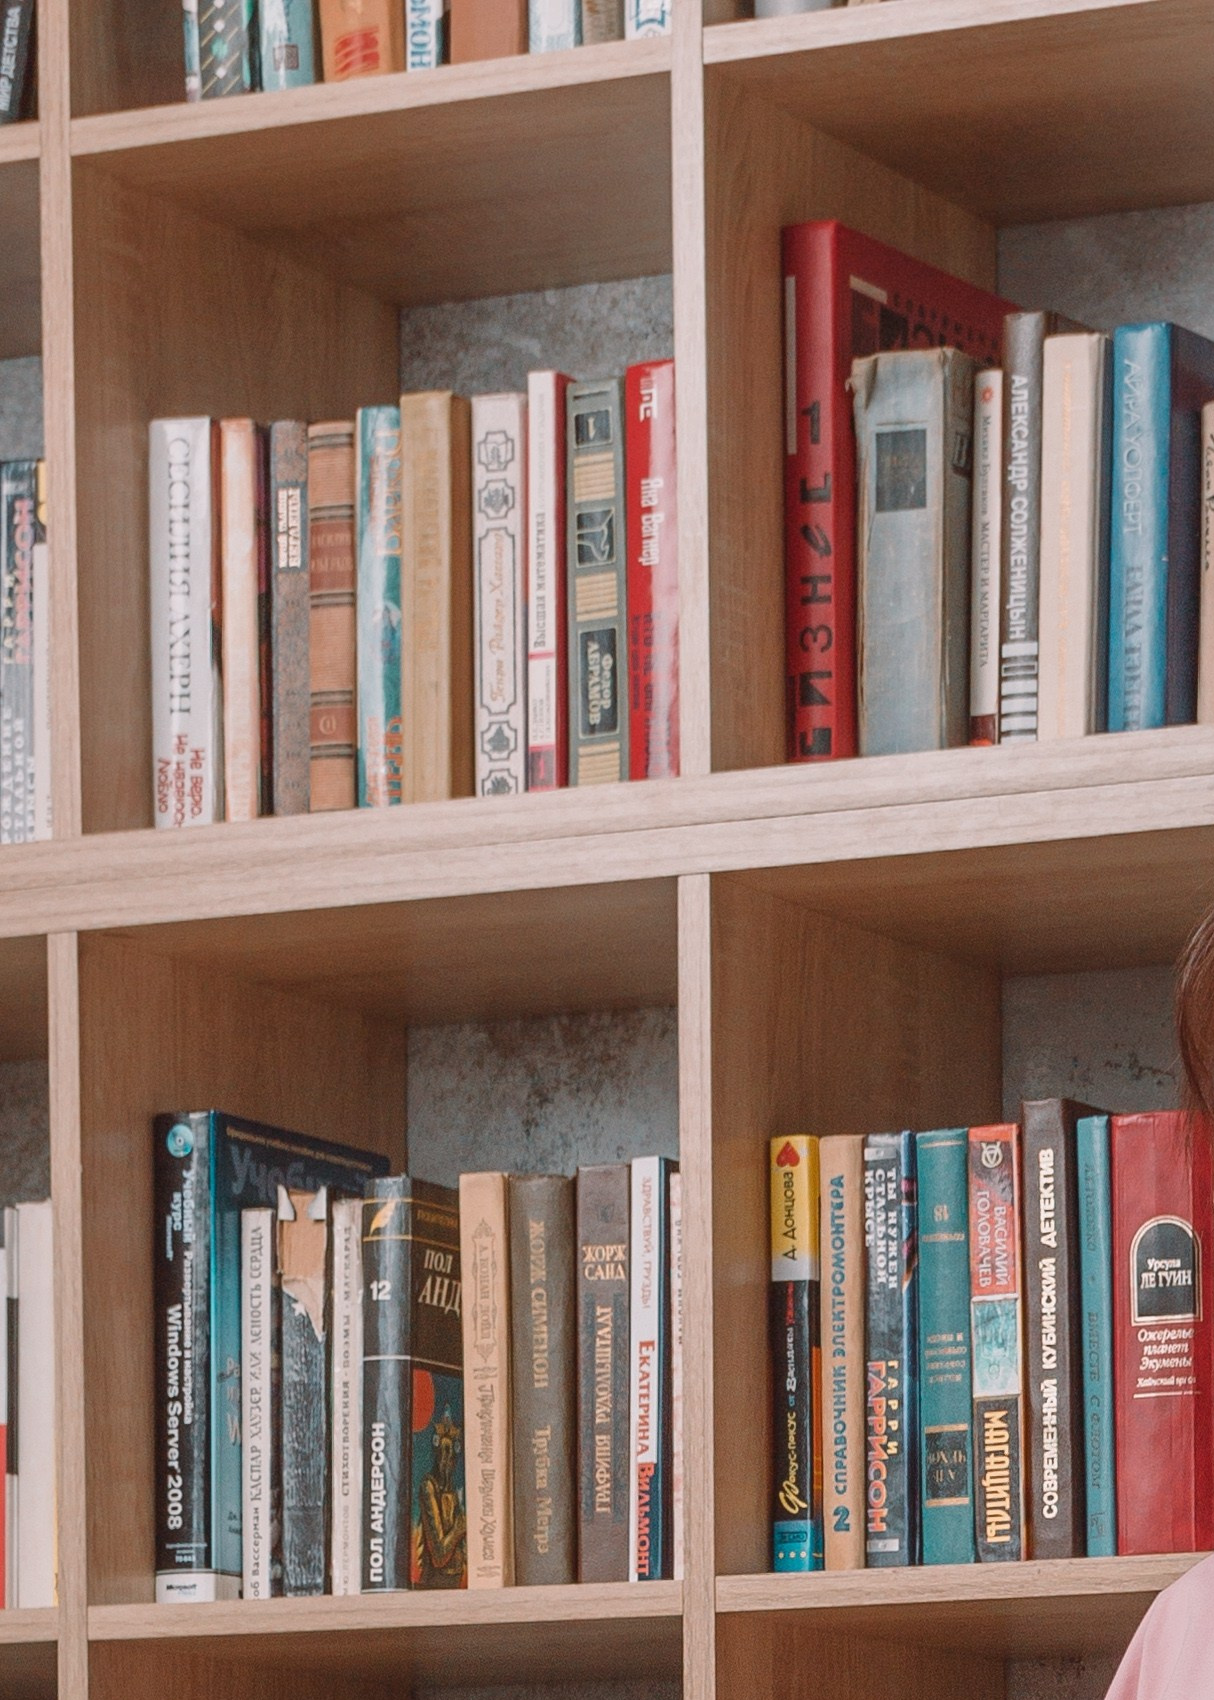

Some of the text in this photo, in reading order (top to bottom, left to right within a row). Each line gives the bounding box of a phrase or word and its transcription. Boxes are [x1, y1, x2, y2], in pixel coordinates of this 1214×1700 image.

[0, 5, 20, 111] МИР ДЕТСТВА
[1122, 358, 1144, 535] АЙРА УОЛФЕРТ
[639, 477, 666, 567] Яна Вагнер
[1007, 375, 1030, 638] АЛЕКСАНДР СОЛЖЕНИЦЫН
[168, 437, 193, 716] СЕСИЛИЯ АХЕРН
[534, 512, 548, 592] математика
[977, 521, 993, 669] МАСТЕР МАРГАРИТА
[534, 595, 548, 649] Высшая
[587, 640, 603, 724] АБРАМОВ
[2, 706, 13, 843] РОЖДЕНИЕ
[14, 718, 25, 843] СТАЛЬНОЙ
[190, 748, 206, 769] Не
[170, 1191, 185, 1229] курс
[181, 1167, 197, 1242] Учебный
[782, 1172, 798, 1242] Донцова
[977, 1190, 994, 1287] ГОЛОВАЧЕВ
[994, 1205, 1011, 1285] ВАСИЛИЙ
[247, 1228, 263, 1280] СЕРДЦА
[341, 1227, 352, 1303] МАСКАРАД
[370, 1279, 391, 1300] 12
[424, 1248, 453, 1272] ПОЛ
[582, 1244, 627, 1260] ЖОРЖ
[887, 1211, 899, 1289] НУЖЕН
[528, 1218, 549, 1388] ЖОРЖ СИМЕНОН
[829, 1174, 849, 1496] СПРАВОЧНИК ЭЛЕКТРОМОНТЕРА
[1038, 1147, 1060, 1518] СОВРЕМЕННЫЙ КУБИНСКИЙ ДЕТЕКТИВ
[166, 1303, 183, 1528] Windows Server 2008
[867, 1360, 889, 1532] ГАРРИСОН
[887, 1359, 900, 1455] ГАРРИ
[533, 1424, 551, 1490] Трубка
[595, 1435, 612, 1513] ГРАФИНЯ
[635, 1338, 656, 1574] ЕКАТЕРИНА ВИЛЬМОНТ
[369, 1421, 386, 1582] ПОЛ АНДЕРСОН
